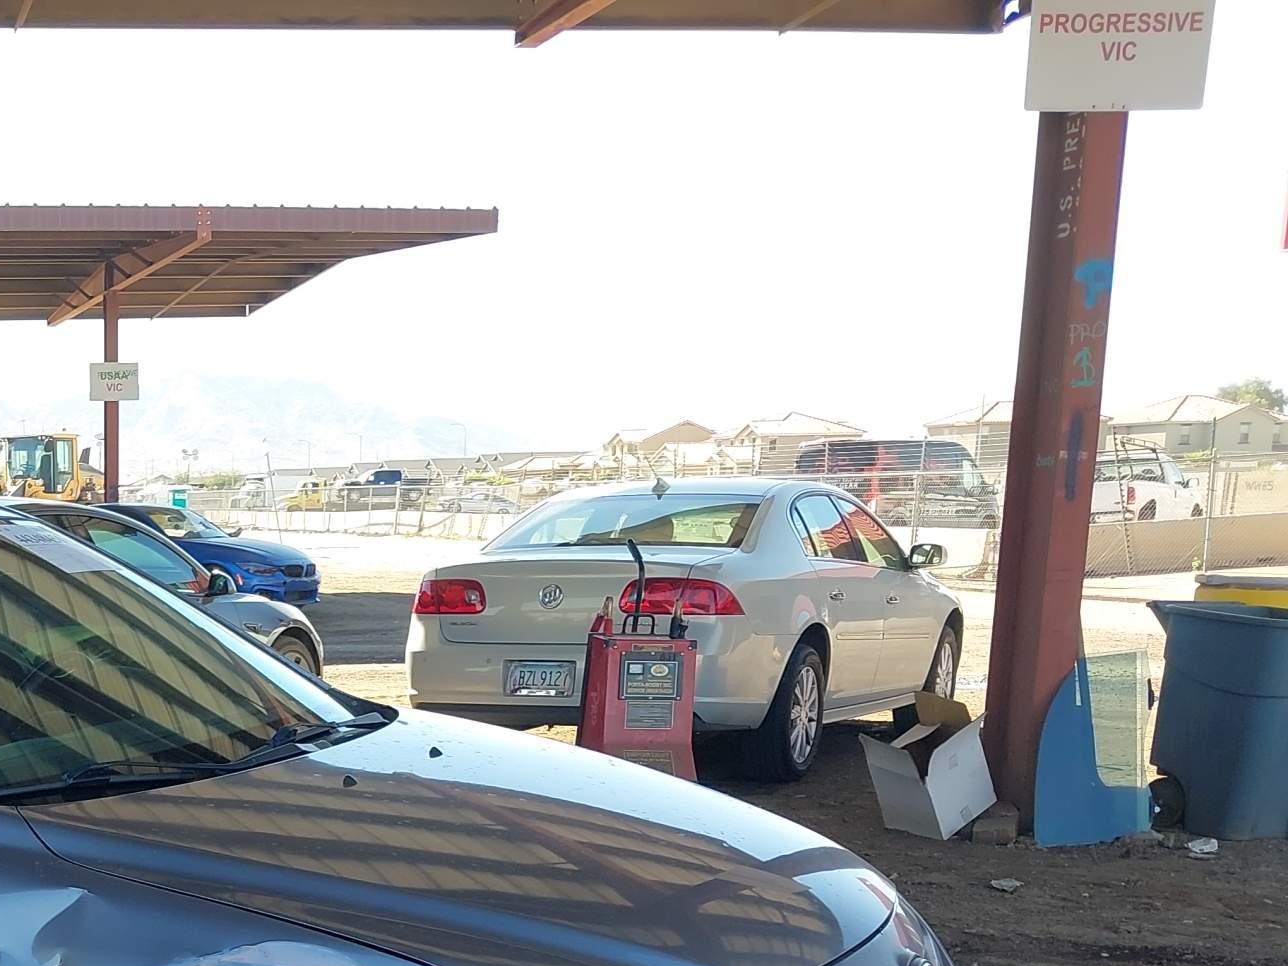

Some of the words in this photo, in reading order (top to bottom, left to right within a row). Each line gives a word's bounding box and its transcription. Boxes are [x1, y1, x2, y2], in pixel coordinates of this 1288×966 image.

[1039, 12, 1204, 33] PROGRESSIVE
[1101, 41, 1137, 61] VIC
[106, 382, 123, 392] VIC
